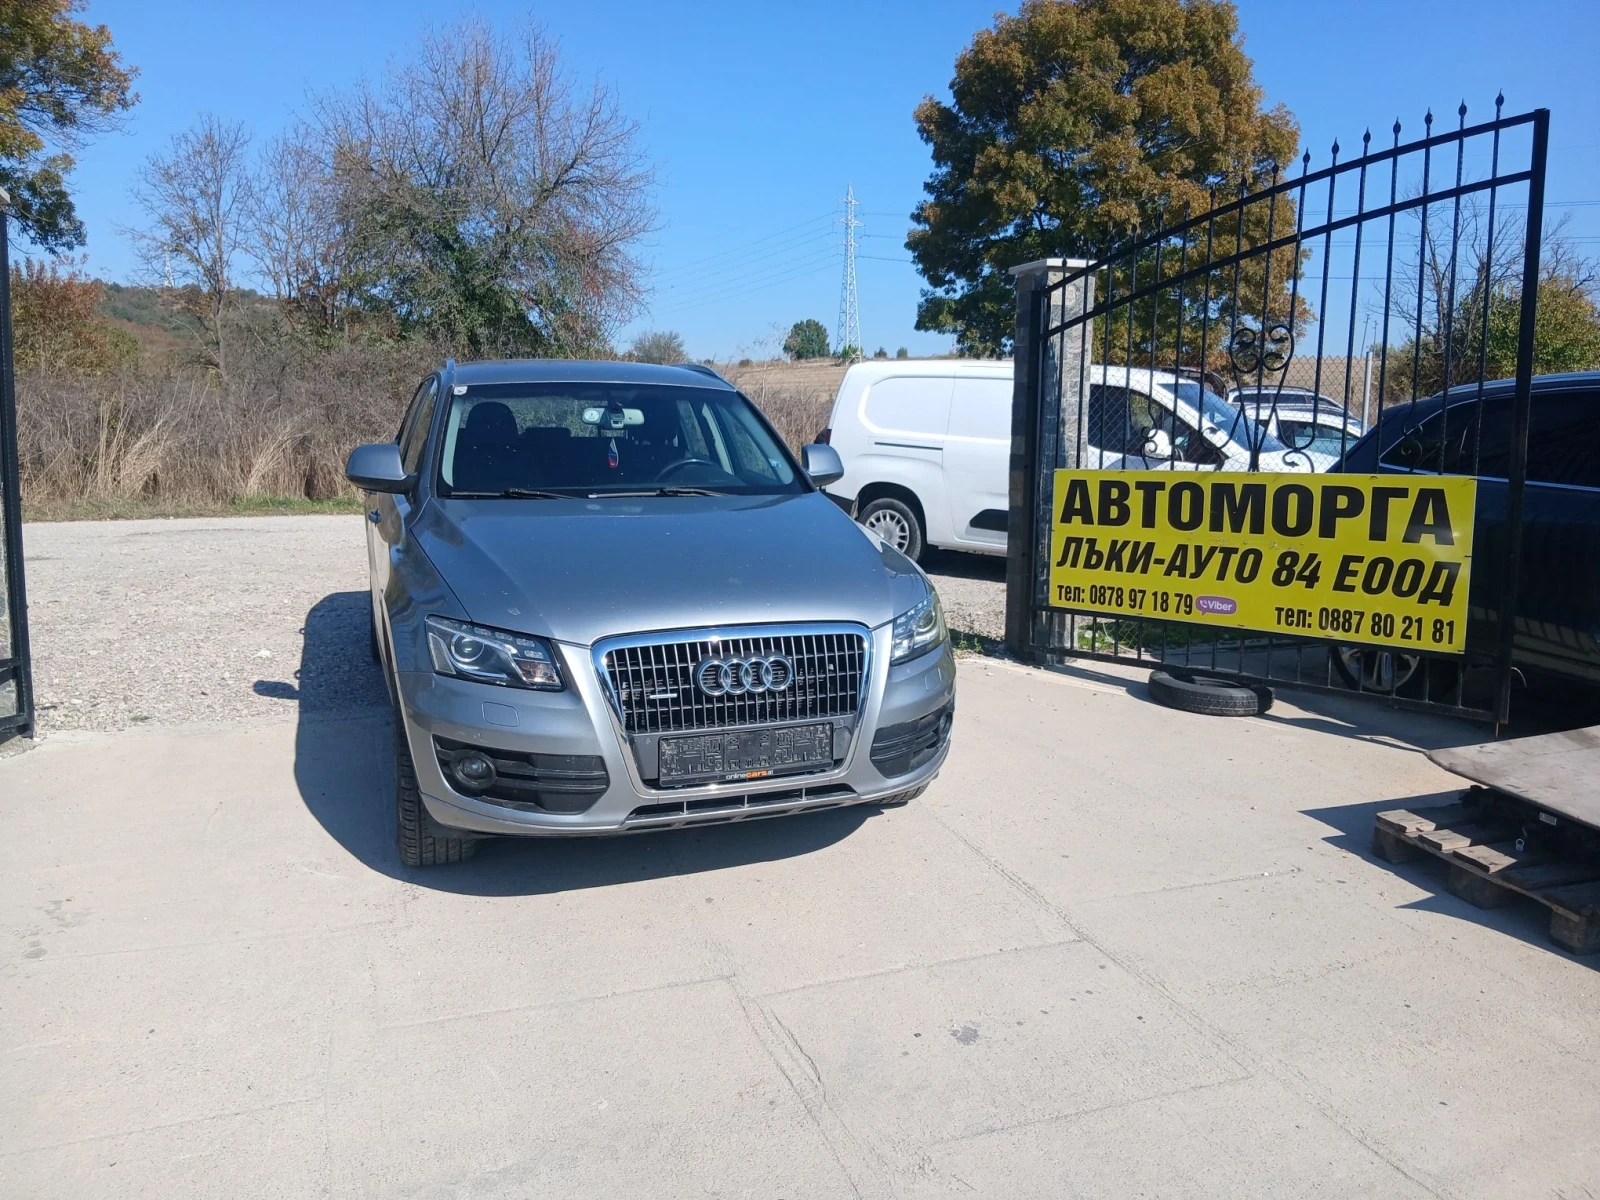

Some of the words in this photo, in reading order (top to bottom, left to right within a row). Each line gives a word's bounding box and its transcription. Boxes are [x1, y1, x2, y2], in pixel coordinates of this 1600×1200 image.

[1060, 479, 1455, 546] АВТОМОРГА
[1056, 536, 1263, 584] ЛЪКИ-АУТО
[1271, 550, 1322, 590] 84
[1332, 554, 1462, 606] ЕООД
[1057, 584, 1085, 604] тел:
[1089, 584, 1124, 608] 0878
[1128, 588, 1147, 610] 97
[1152, 590, 1169, 614] 18
[1174, 592, 1193, 616] 79
[1207, 601, 1233, 612] Viber
[1275, 606, 1312, 629] тел:
[1318, 606, 1365, 634] 0887
[1370, 612, 1395, 638] 80
[1400, 615, 1423, 641] 21
[1431, 618, 1455, 645] 81
